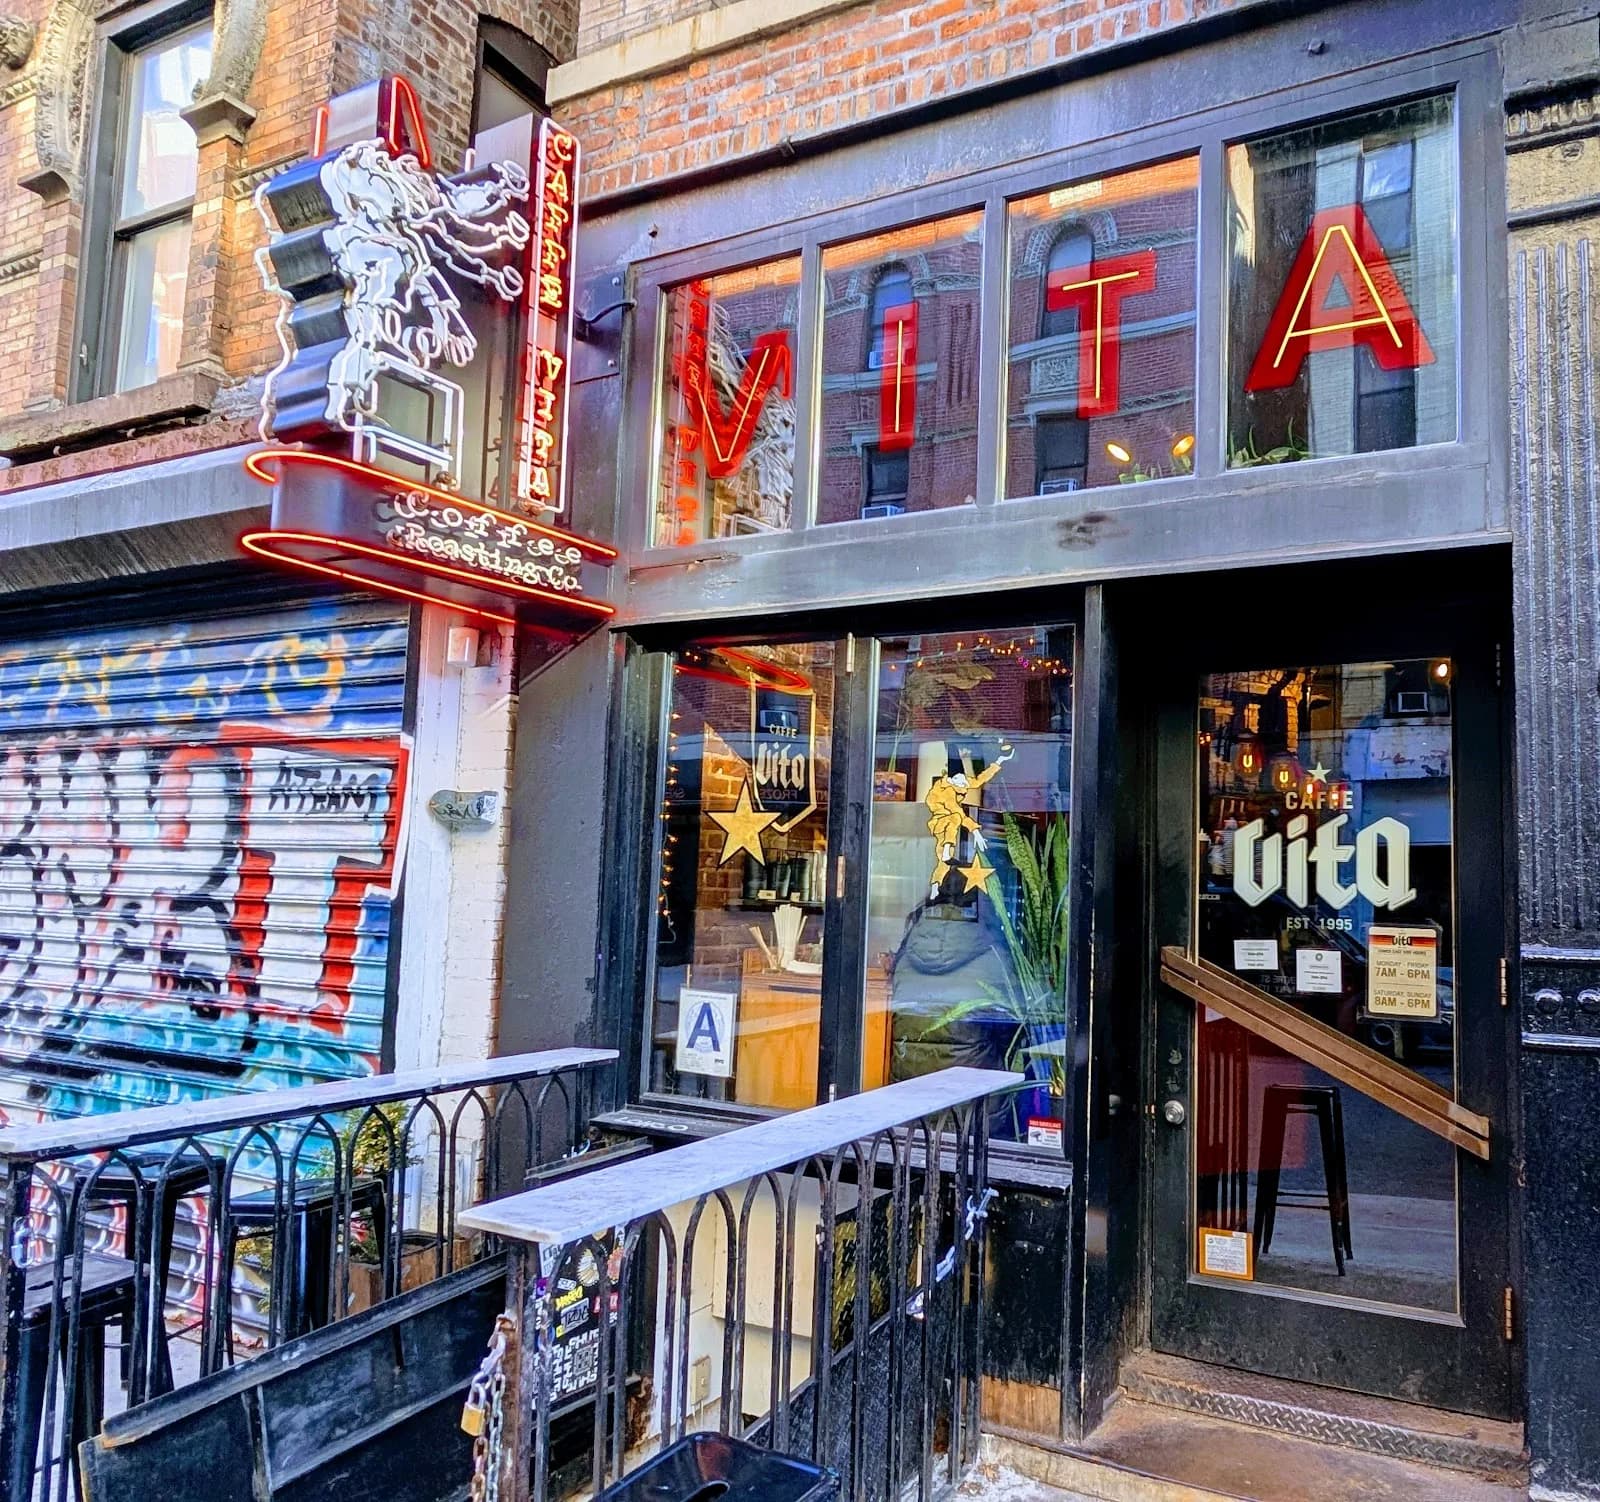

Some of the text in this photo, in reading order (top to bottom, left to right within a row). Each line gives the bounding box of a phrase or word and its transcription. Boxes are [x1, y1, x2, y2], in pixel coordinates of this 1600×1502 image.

[531, 131, 574, 498] CAFFE VITA
[679, 203, 1437, 479] VITA
[393, 490, 582, 565] Coffee
[386, 522, 548, 587] Roasting
[769, 723, 797, 739] CAFFE
[1285, 790, 1355, 810] CAFFE
[1286, 916, 1353, 931] EST 1995
[1375, 966, 1397, 978] 7AM
[1407, 968, 1431, 980] 6PM
[1376, 959, 1401, 967] MONDAY
[1407, 961, 1430, 969] FRIDAY
[1374, 996, 1397, 1007] 8AM
[1407, 998, 1431, 1010] 6PM
[686, 1001, 721, 1052] A
